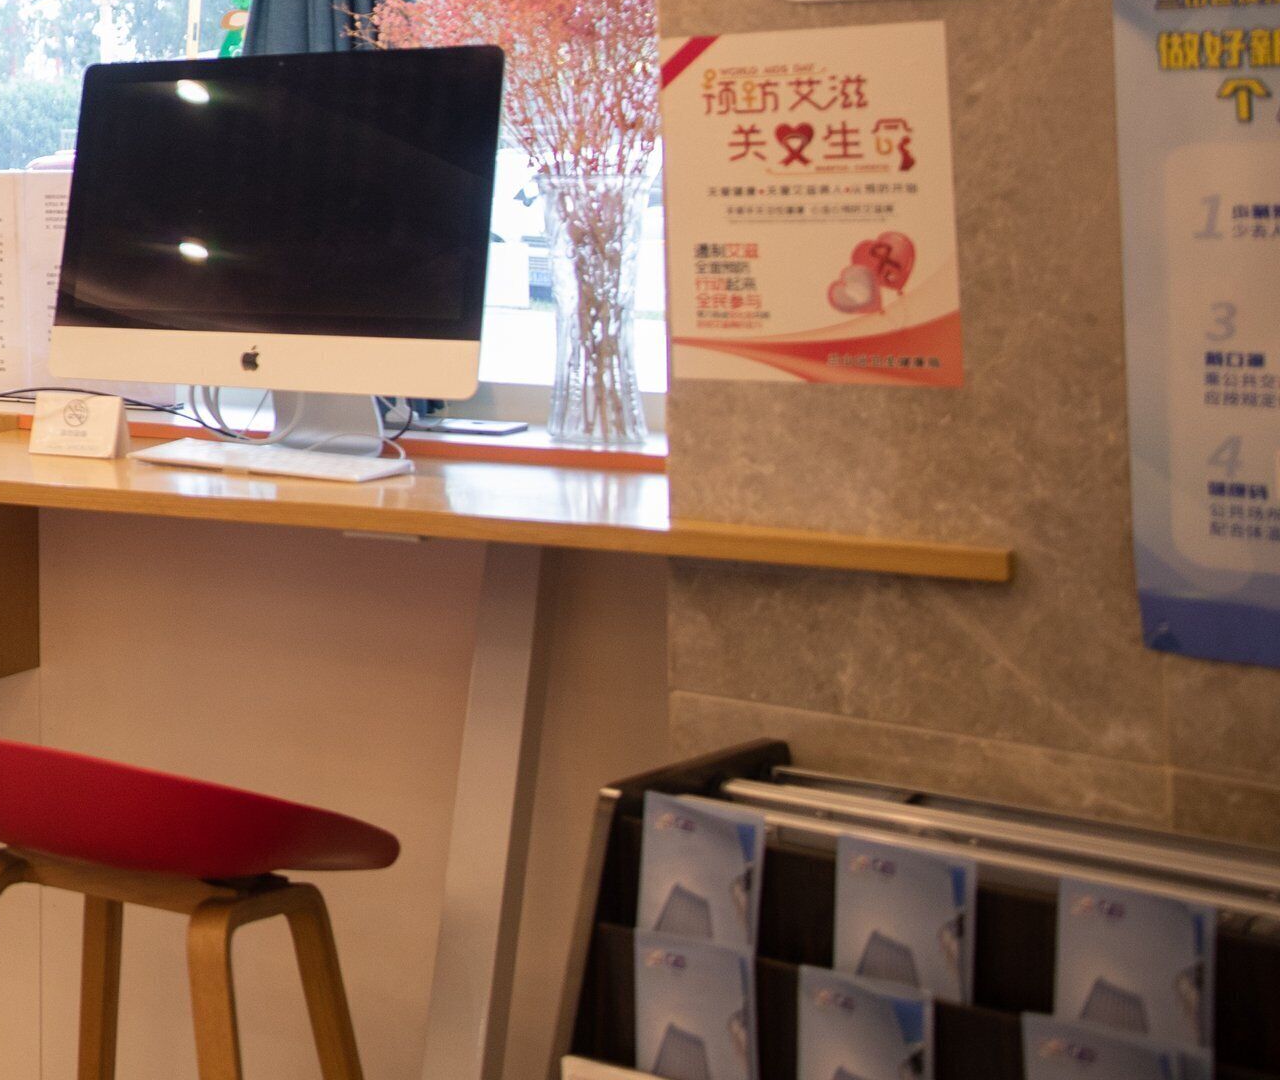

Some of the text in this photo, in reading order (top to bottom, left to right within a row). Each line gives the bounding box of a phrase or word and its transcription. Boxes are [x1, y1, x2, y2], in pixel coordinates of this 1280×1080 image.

[702, 69, 869, 116] 预防艾滋
[695, 293, 763, 310] 全民参与
